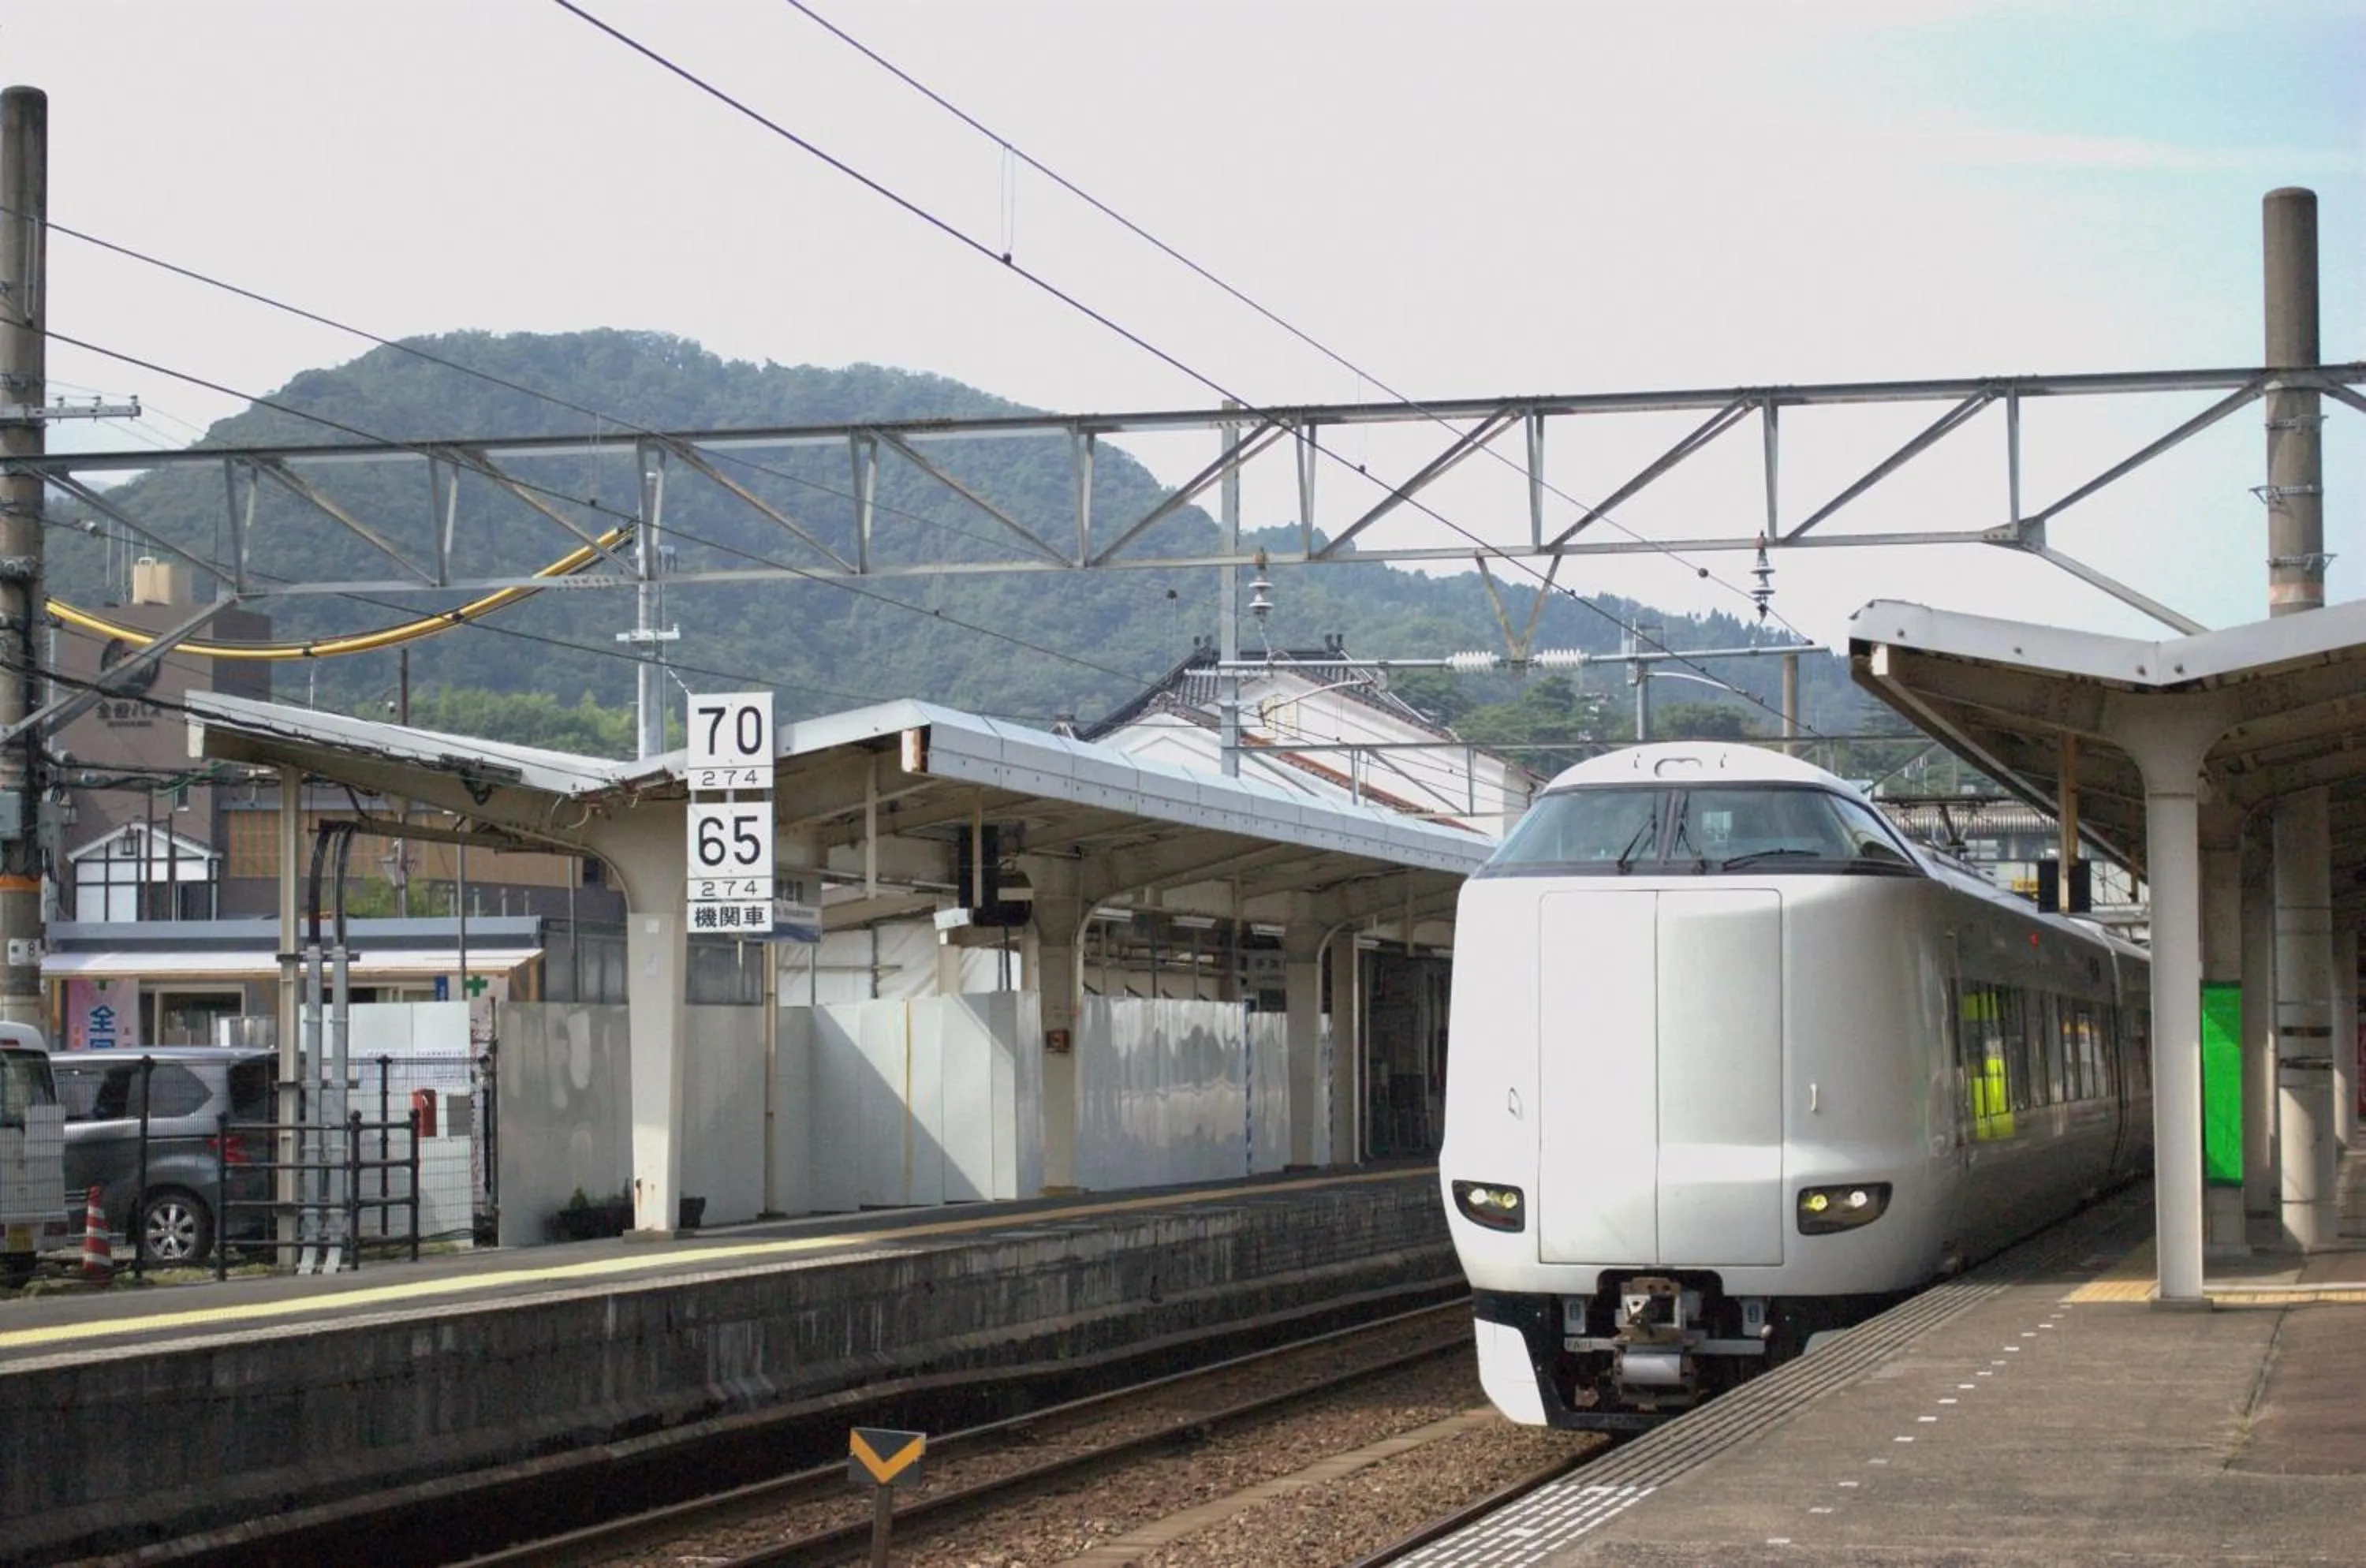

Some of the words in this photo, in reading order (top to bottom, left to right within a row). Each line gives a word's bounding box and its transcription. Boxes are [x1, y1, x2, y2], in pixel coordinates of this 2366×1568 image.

[698, 706, 762, 756] 70
[702, 770, 758, 786] 274
[698, 815, 761, 867] 65
[701, 879, 758, 897] 274
[694, 906, 766, 928] 機関車
